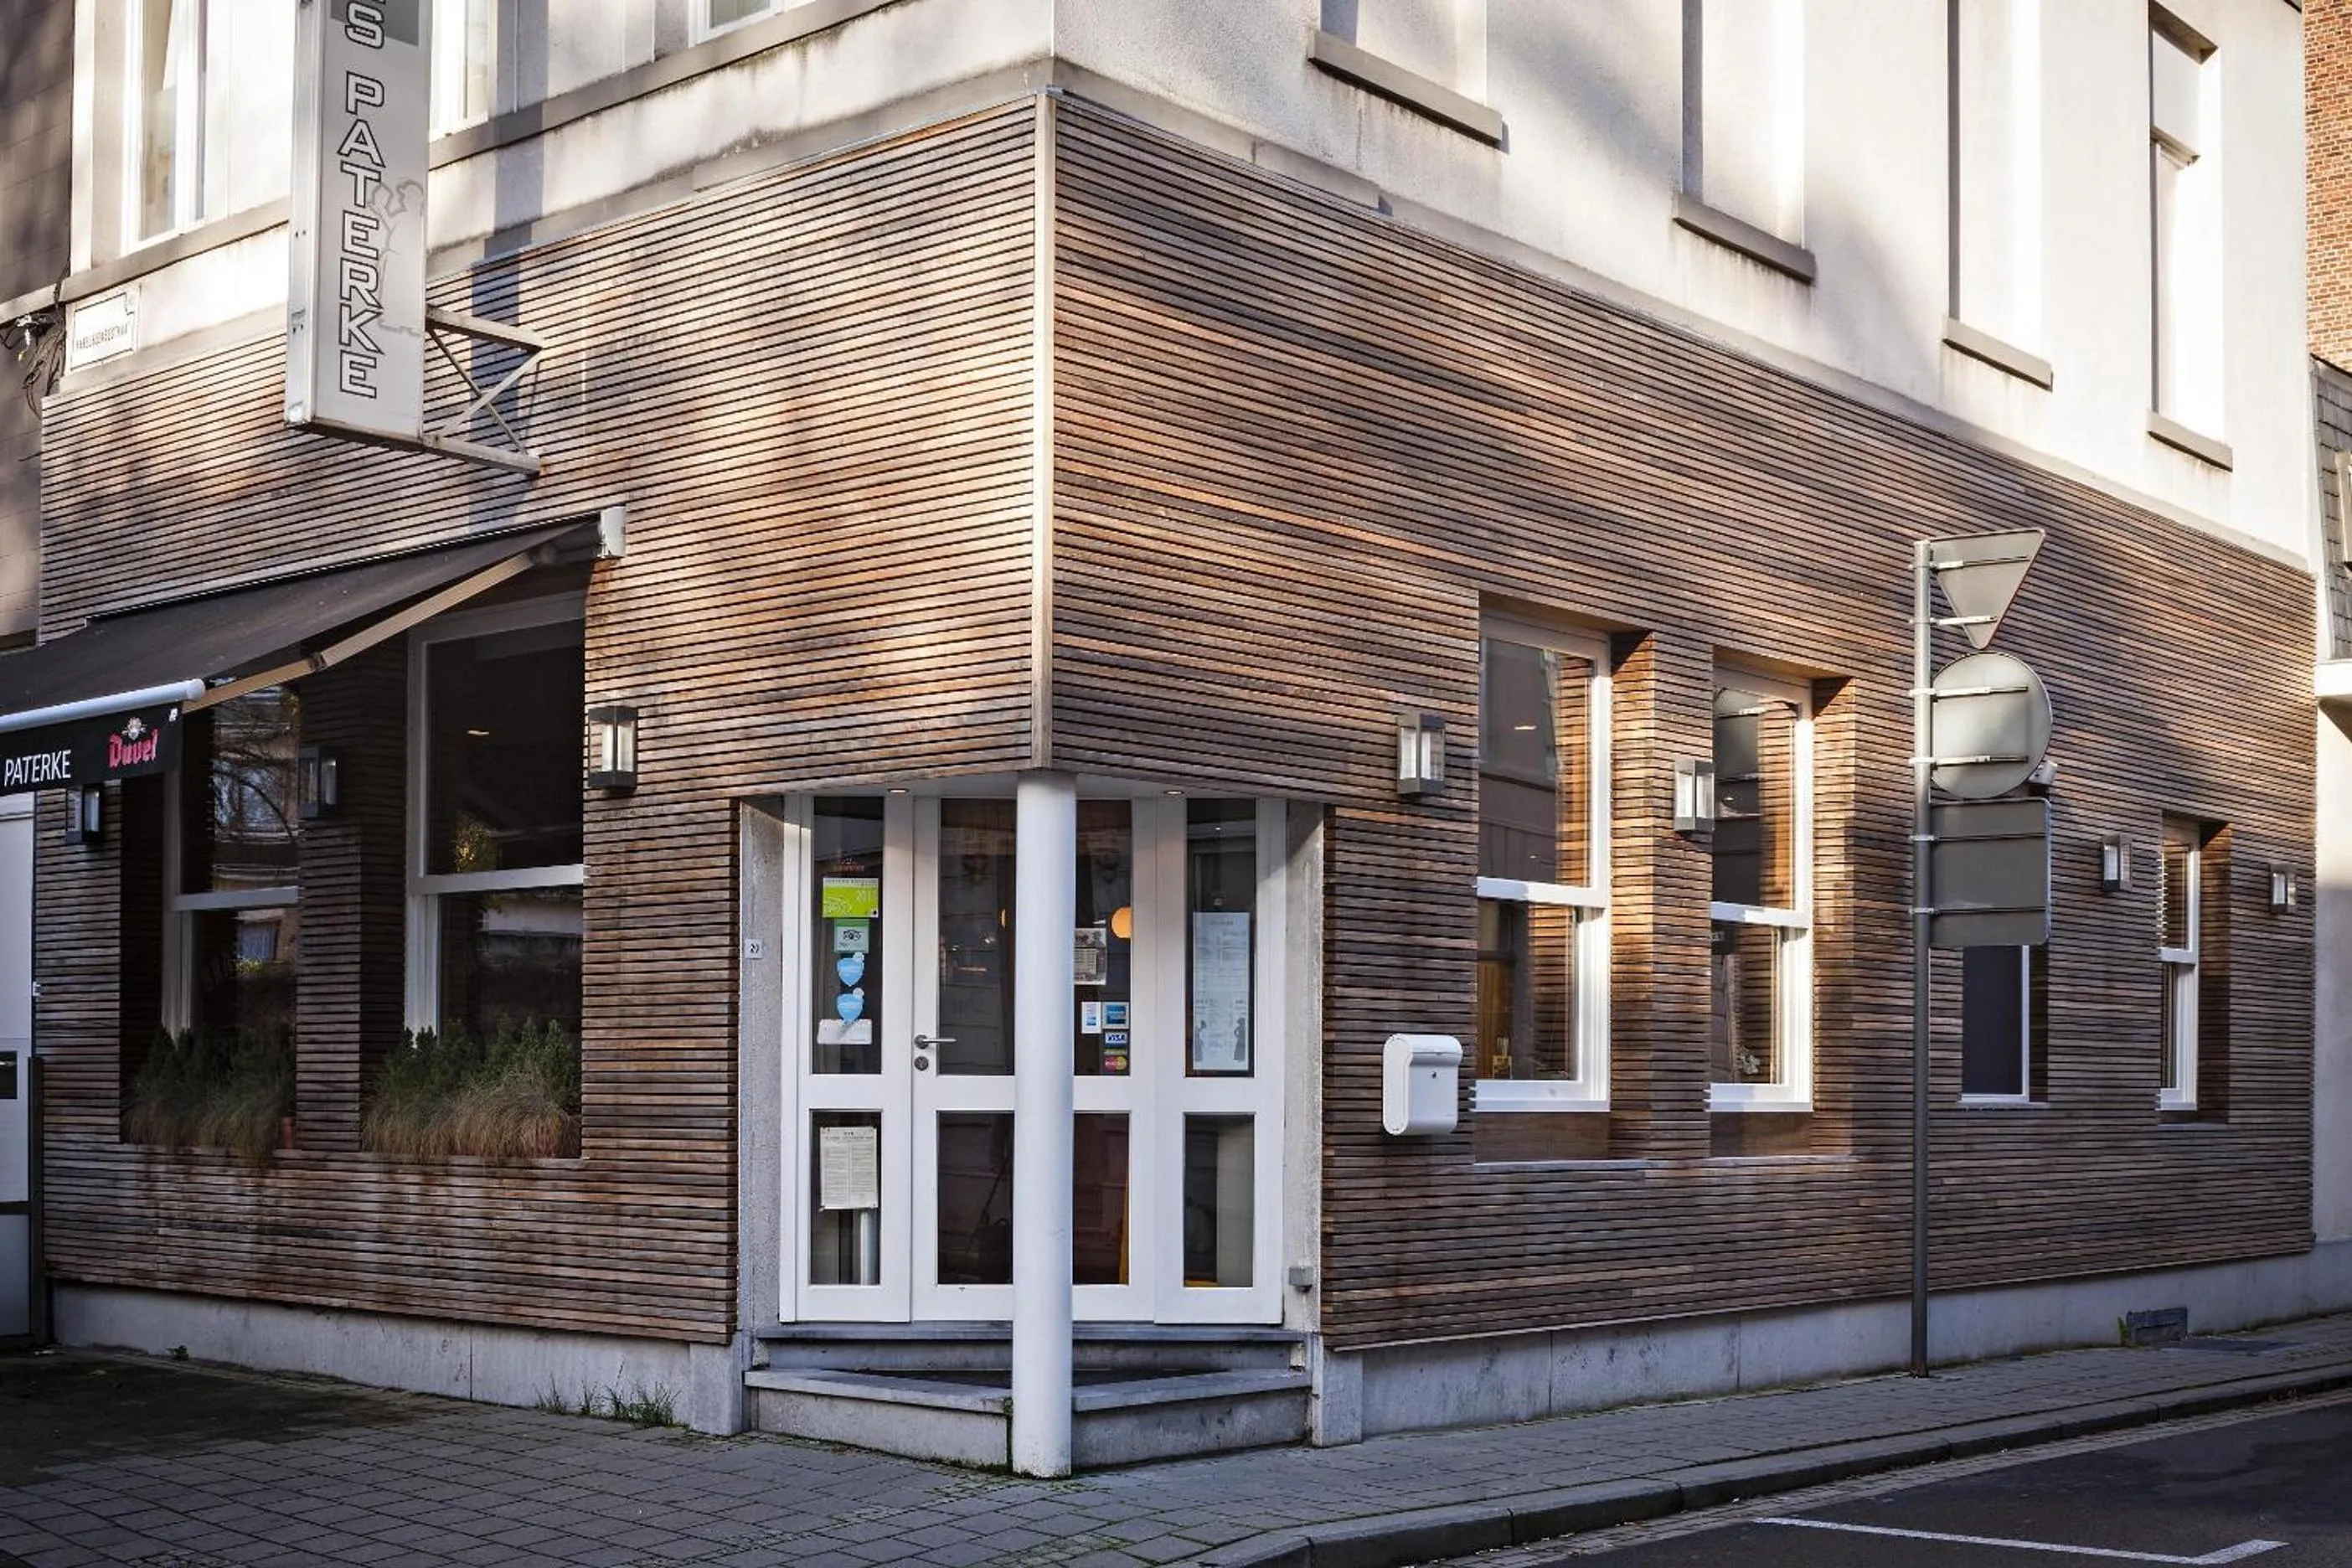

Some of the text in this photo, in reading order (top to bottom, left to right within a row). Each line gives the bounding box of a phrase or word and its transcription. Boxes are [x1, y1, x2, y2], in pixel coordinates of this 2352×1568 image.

[337, 0, 386, 399] S PATERKE
[4, 749, 71, 787] PATERKE
[108, 728, 158, 768] Duvel
